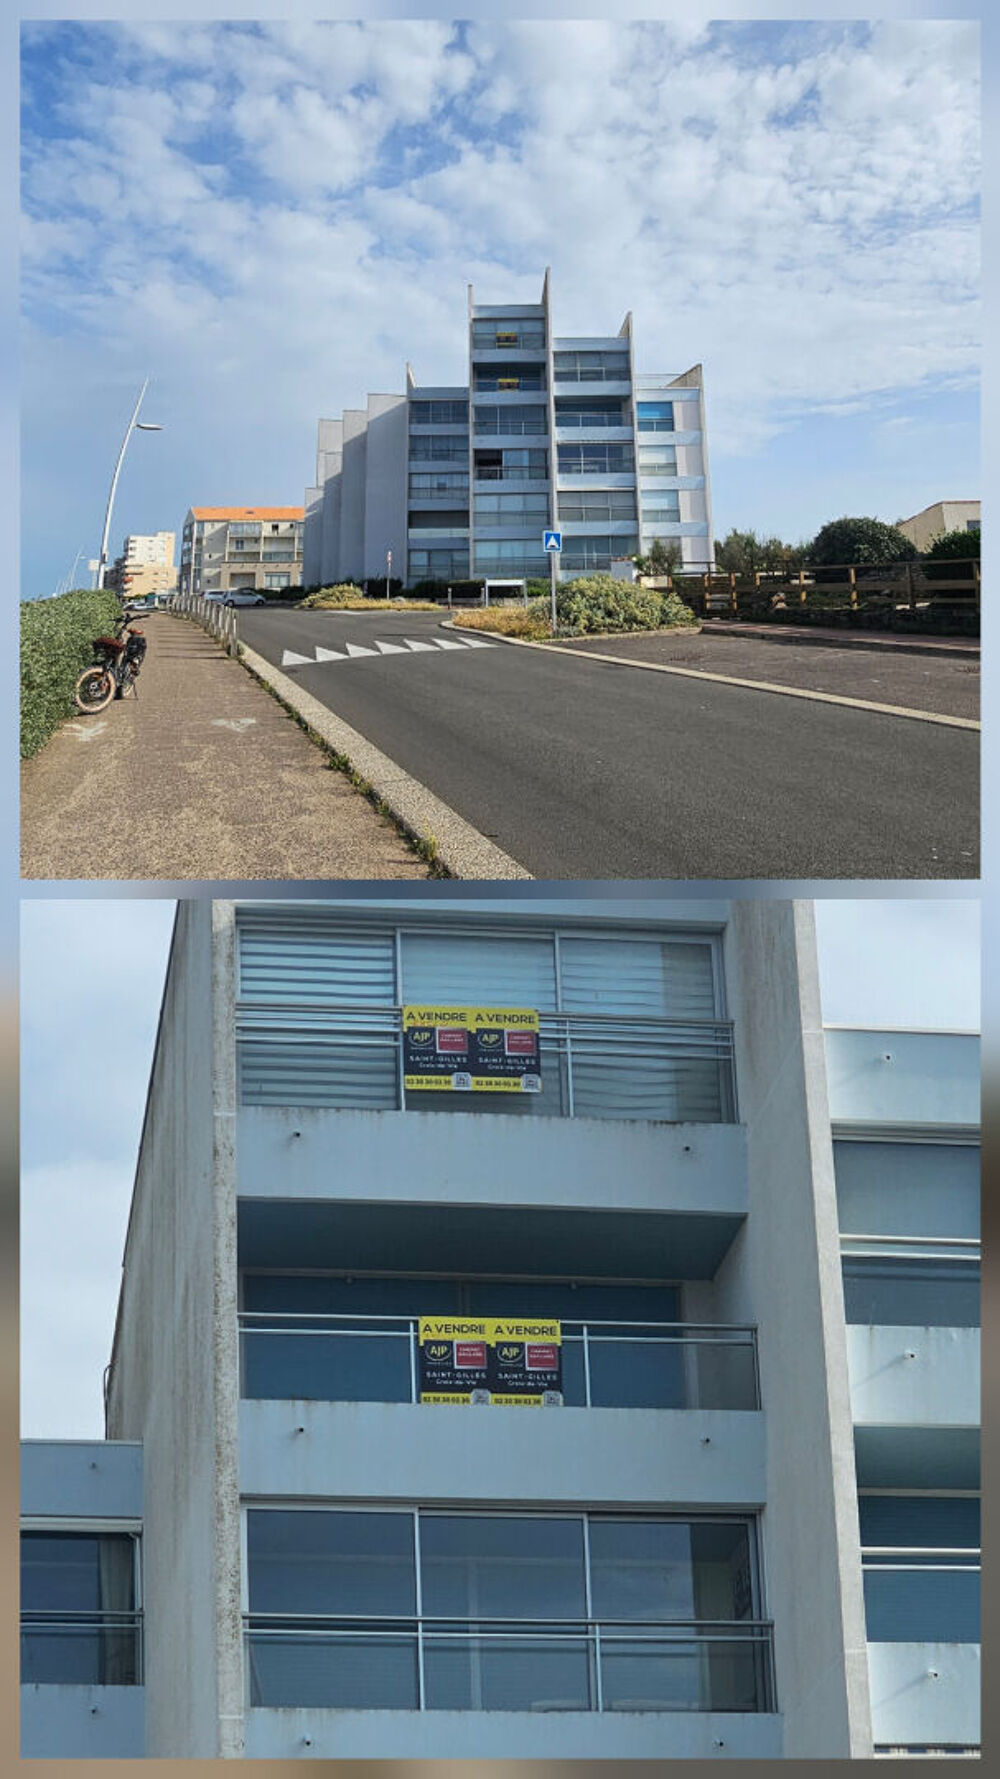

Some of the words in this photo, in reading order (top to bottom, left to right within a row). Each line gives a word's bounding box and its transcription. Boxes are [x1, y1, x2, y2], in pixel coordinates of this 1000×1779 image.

[407, 1012, 415, 1020] A
[418, 1012, 467, 1021] VENDRE
[475, 1014, 484, 1022] A
[487, 1014, 534, 1023] VENDRE
[413, 1032, 430, 1041] AJP
[481, 1034, 499, 1043] AJP
[423, 1324, 432, 1333] A
[435, 1324, 485, 1334] VENDRE
[495, 1326, 504, 1335] A
[507, 1326, 557, 1336] VENDRE
[430, 1345, 447, 1356] AJP
[501, 1347, 519, 1357] AJP
